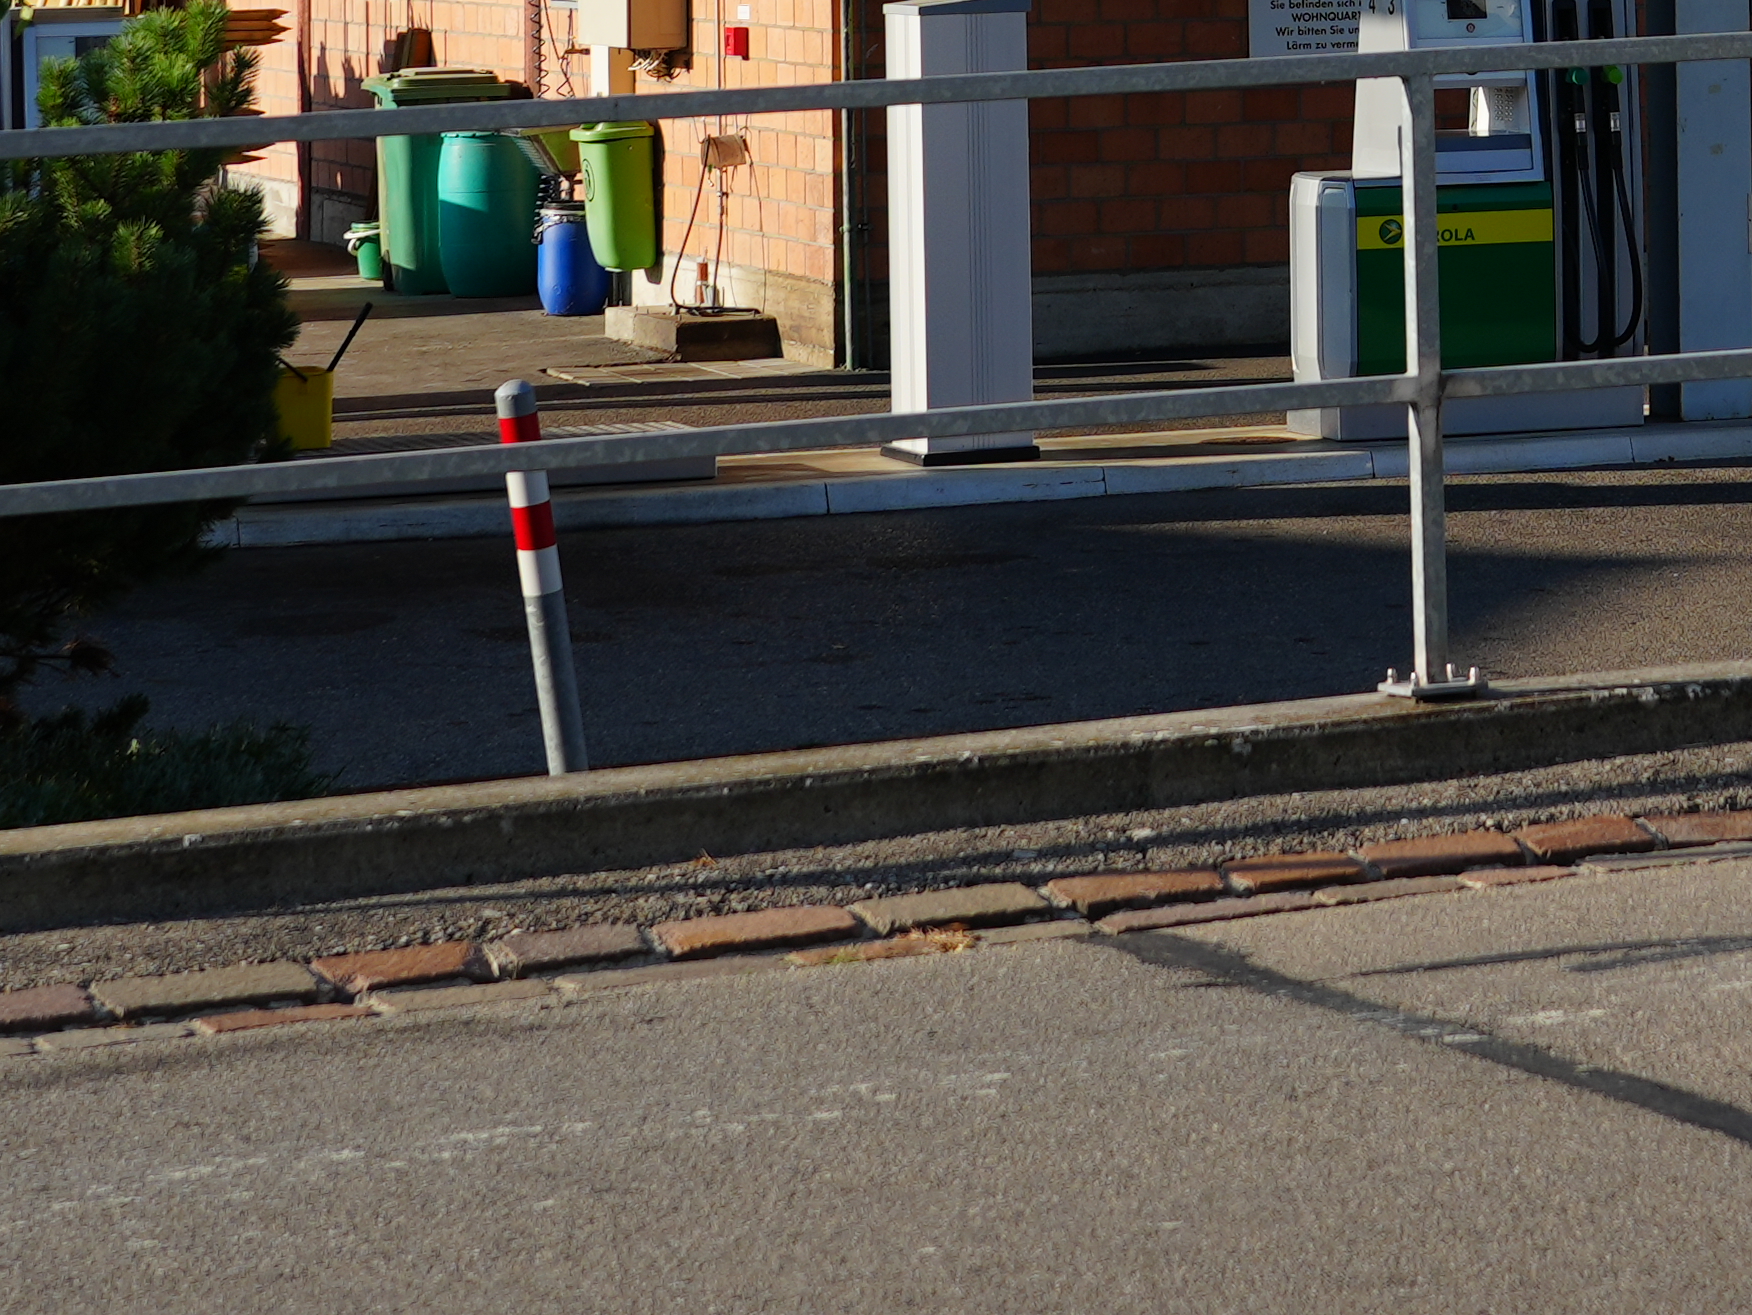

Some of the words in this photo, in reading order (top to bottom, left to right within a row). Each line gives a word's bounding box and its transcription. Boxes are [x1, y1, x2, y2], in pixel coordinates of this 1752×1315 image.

[1270, 0, 1286, 10] Sie
[1291, 10, 1362, 23] WOHNQUAR
[1275, 26, 1295, 37] Wir
[1297, 25, 1327, 37] bitten
[1330, 25, 1345, 36] Sie
[1286, 40, 1312, 51] Lärm
[1315, 42, 1328, 51] zu
[1436, 227, 1476, 243] OLA
